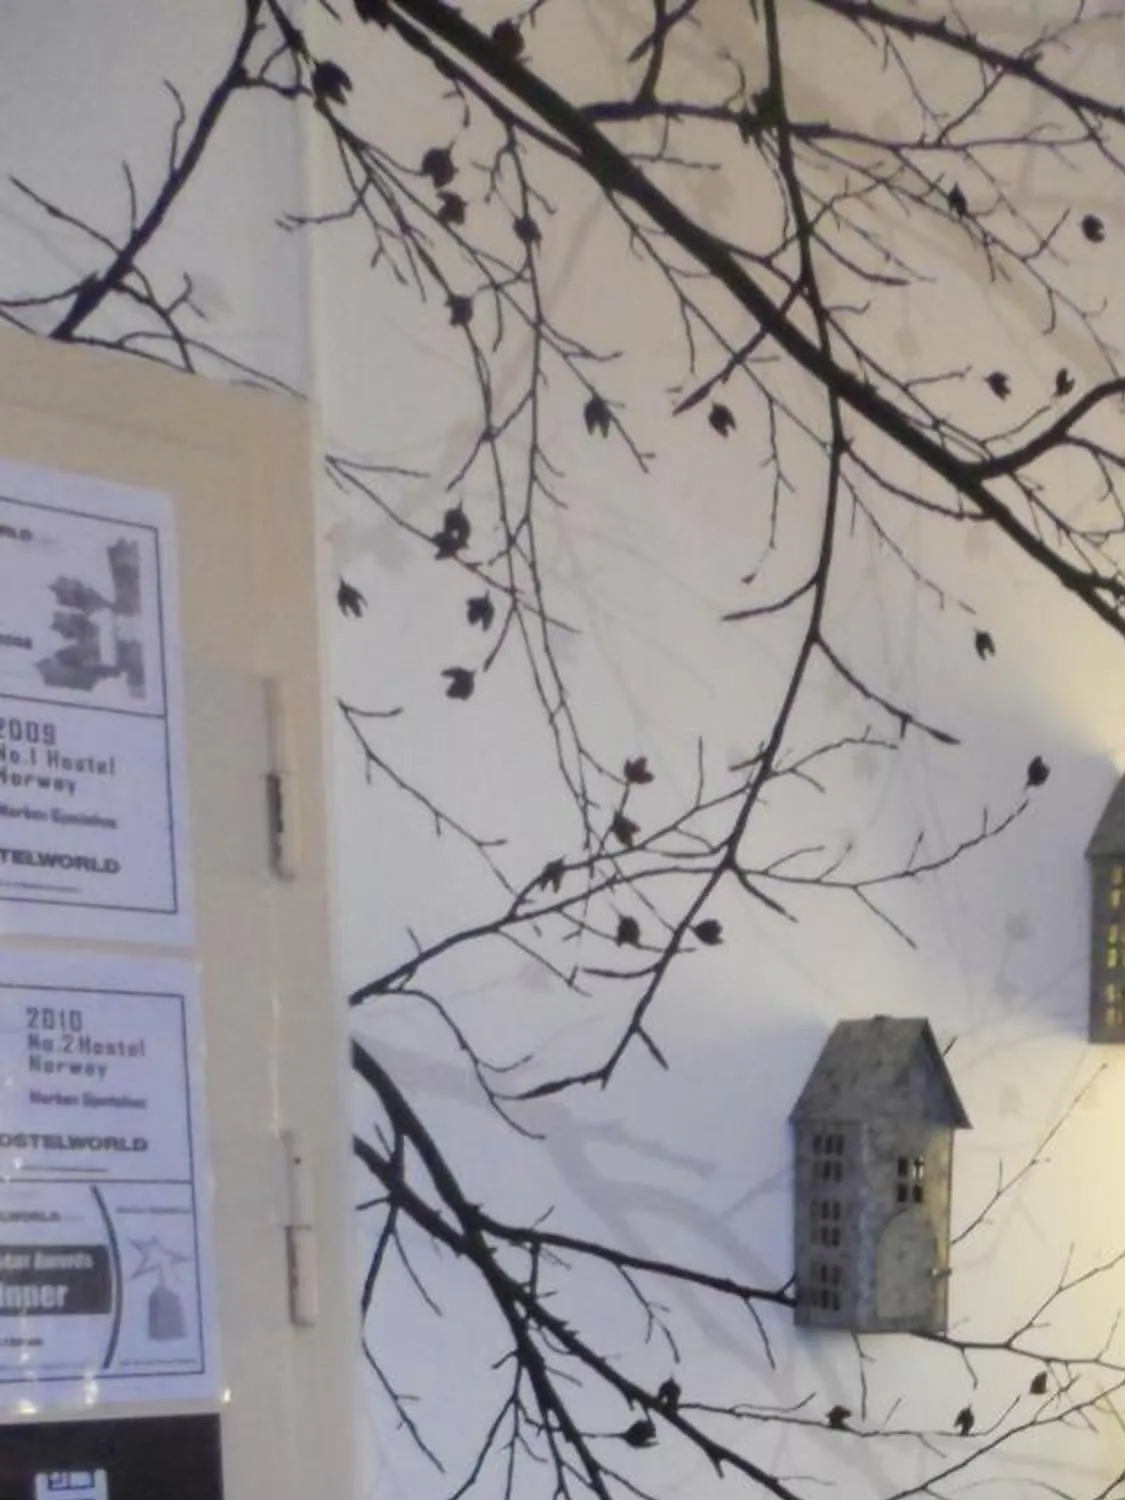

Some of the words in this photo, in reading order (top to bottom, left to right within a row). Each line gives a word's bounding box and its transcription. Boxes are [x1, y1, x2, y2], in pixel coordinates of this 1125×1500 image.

[47, 749, 115, 778] Hostel
[26, 1007, 82, 1032] 2010
[29, 1054, 107, 1082] Norway
